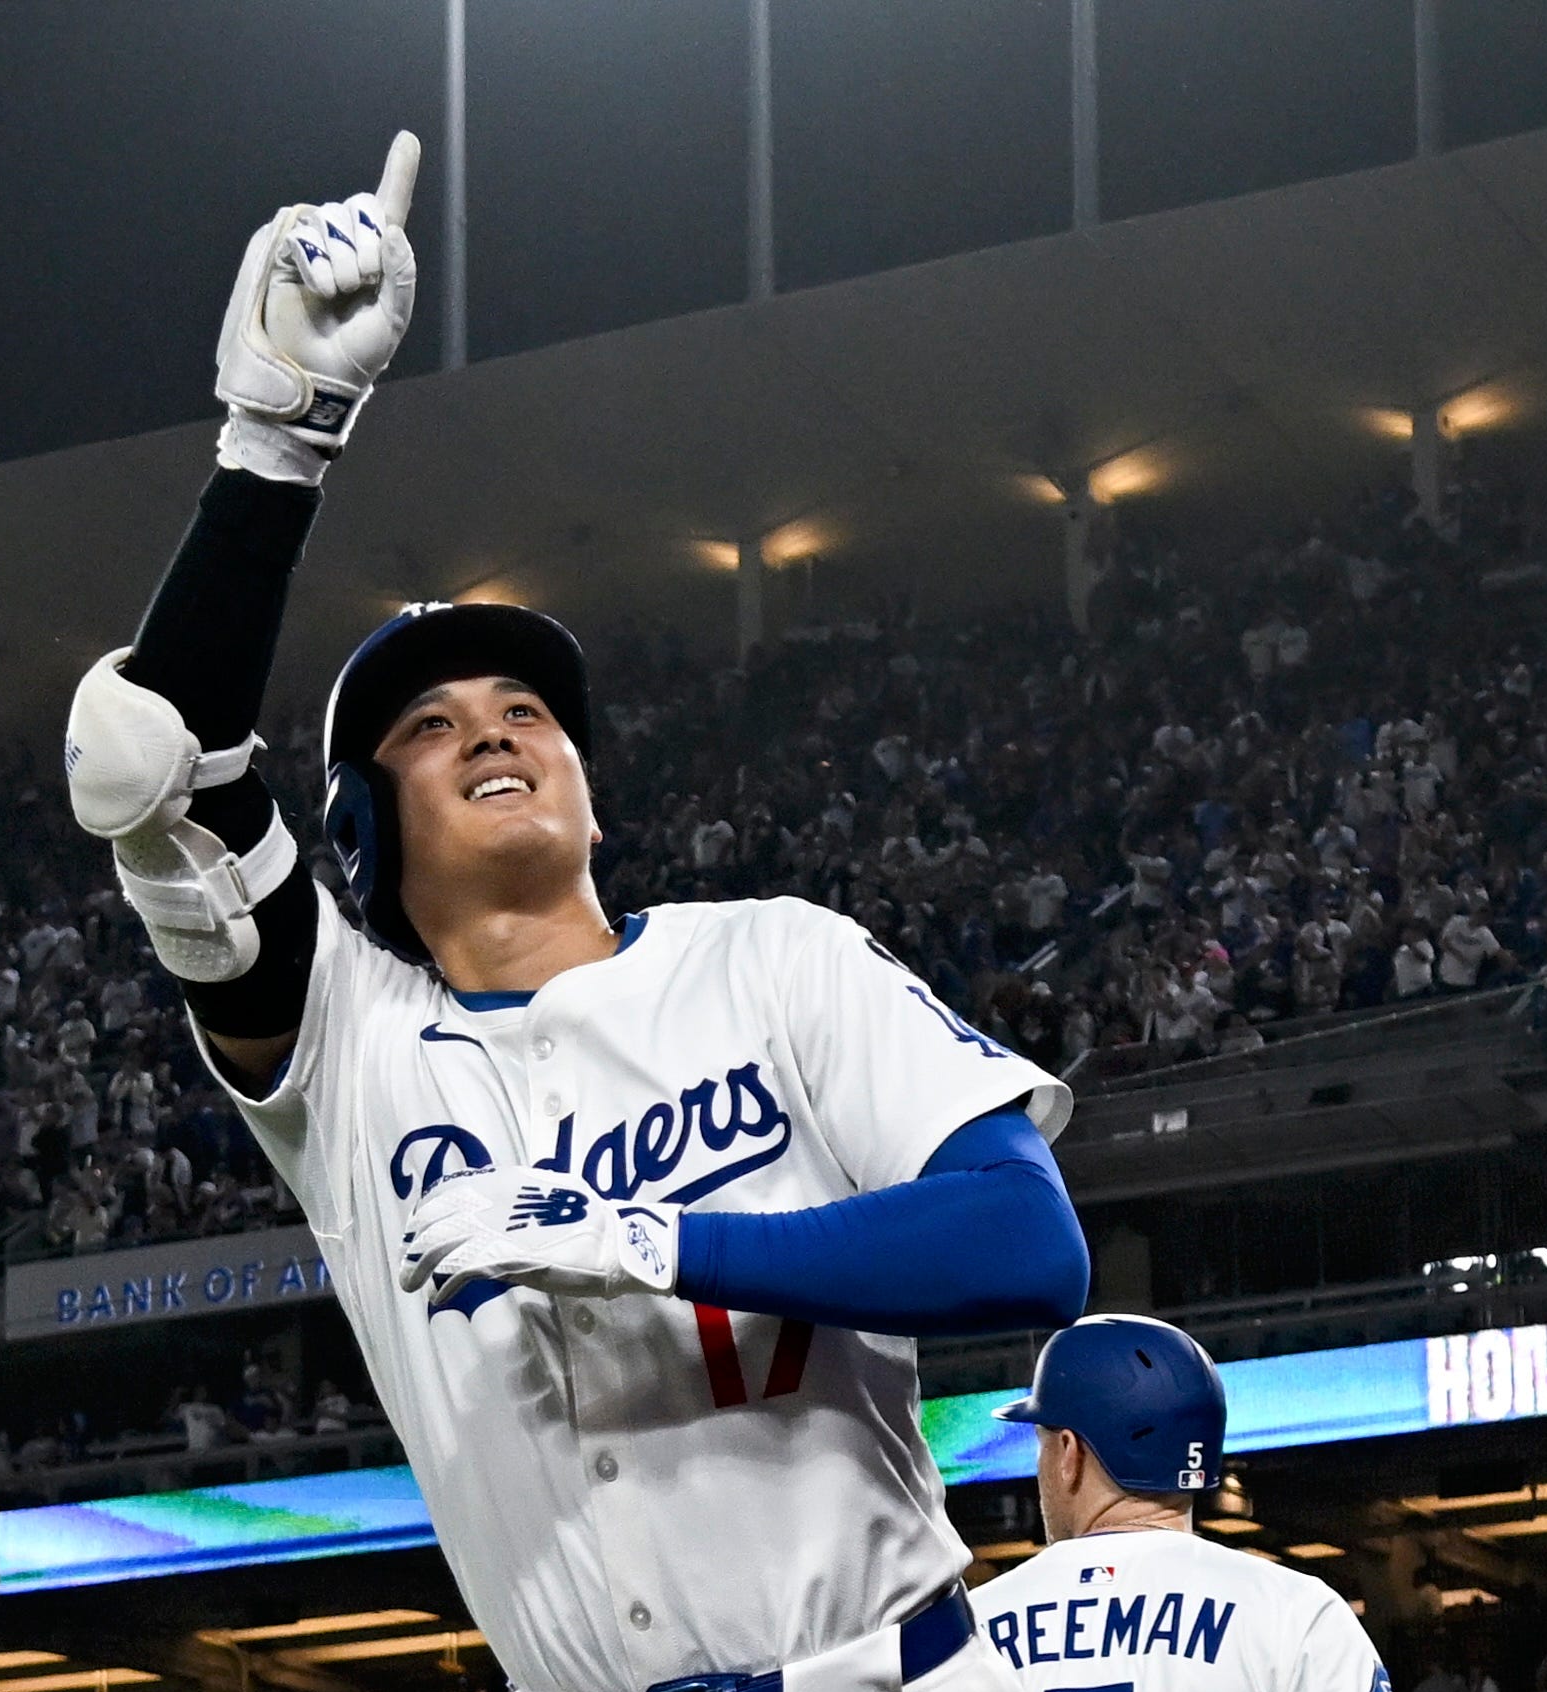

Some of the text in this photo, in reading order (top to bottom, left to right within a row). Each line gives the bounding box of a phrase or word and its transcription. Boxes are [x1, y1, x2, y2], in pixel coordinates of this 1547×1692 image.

[57, 1271, 189, 1324] BANK
[203, 1259, 265, 1303] OF
[1187, 1442, 1203, 1470] 5
[981, 1593, 1237, 1671] REEMAN
